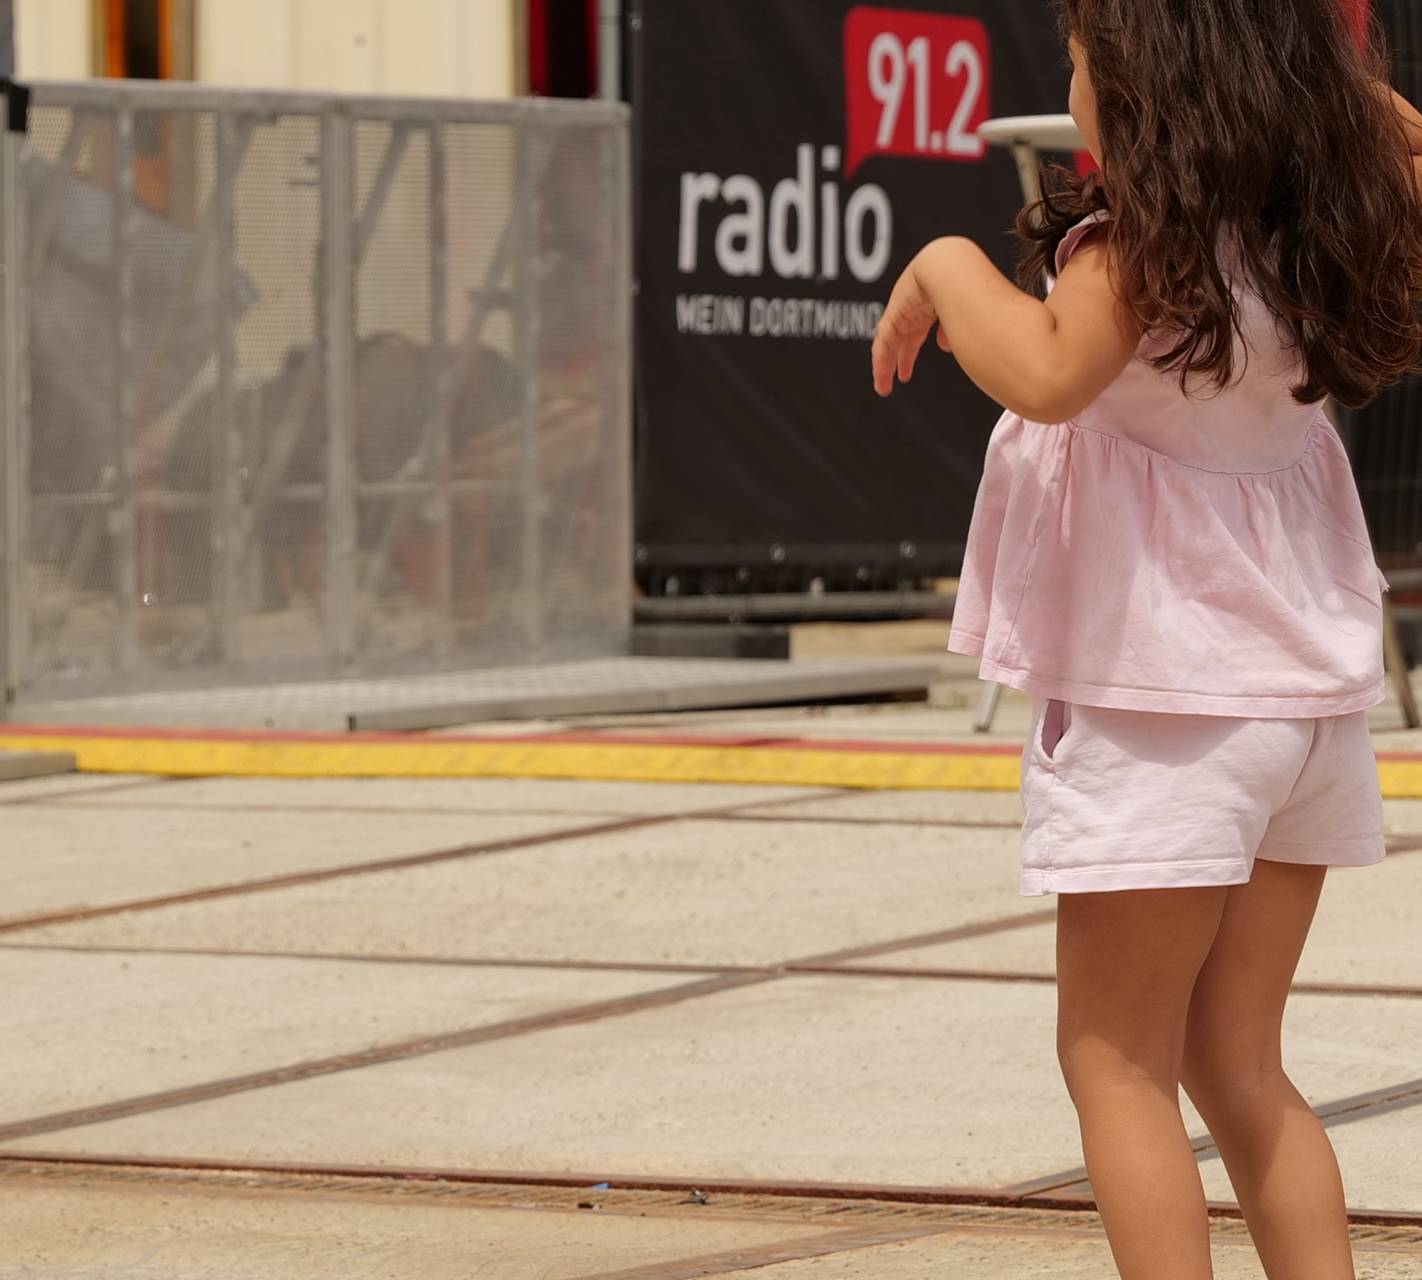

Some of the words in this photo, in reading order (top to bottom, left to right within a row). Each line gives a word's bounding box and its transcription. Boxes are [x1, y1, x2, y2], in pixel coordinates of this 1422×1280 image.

[867, 31, 984, 157] 91.2
[677, 142, 894, 283] radio
[676, 294, 745, 335] MEIN
